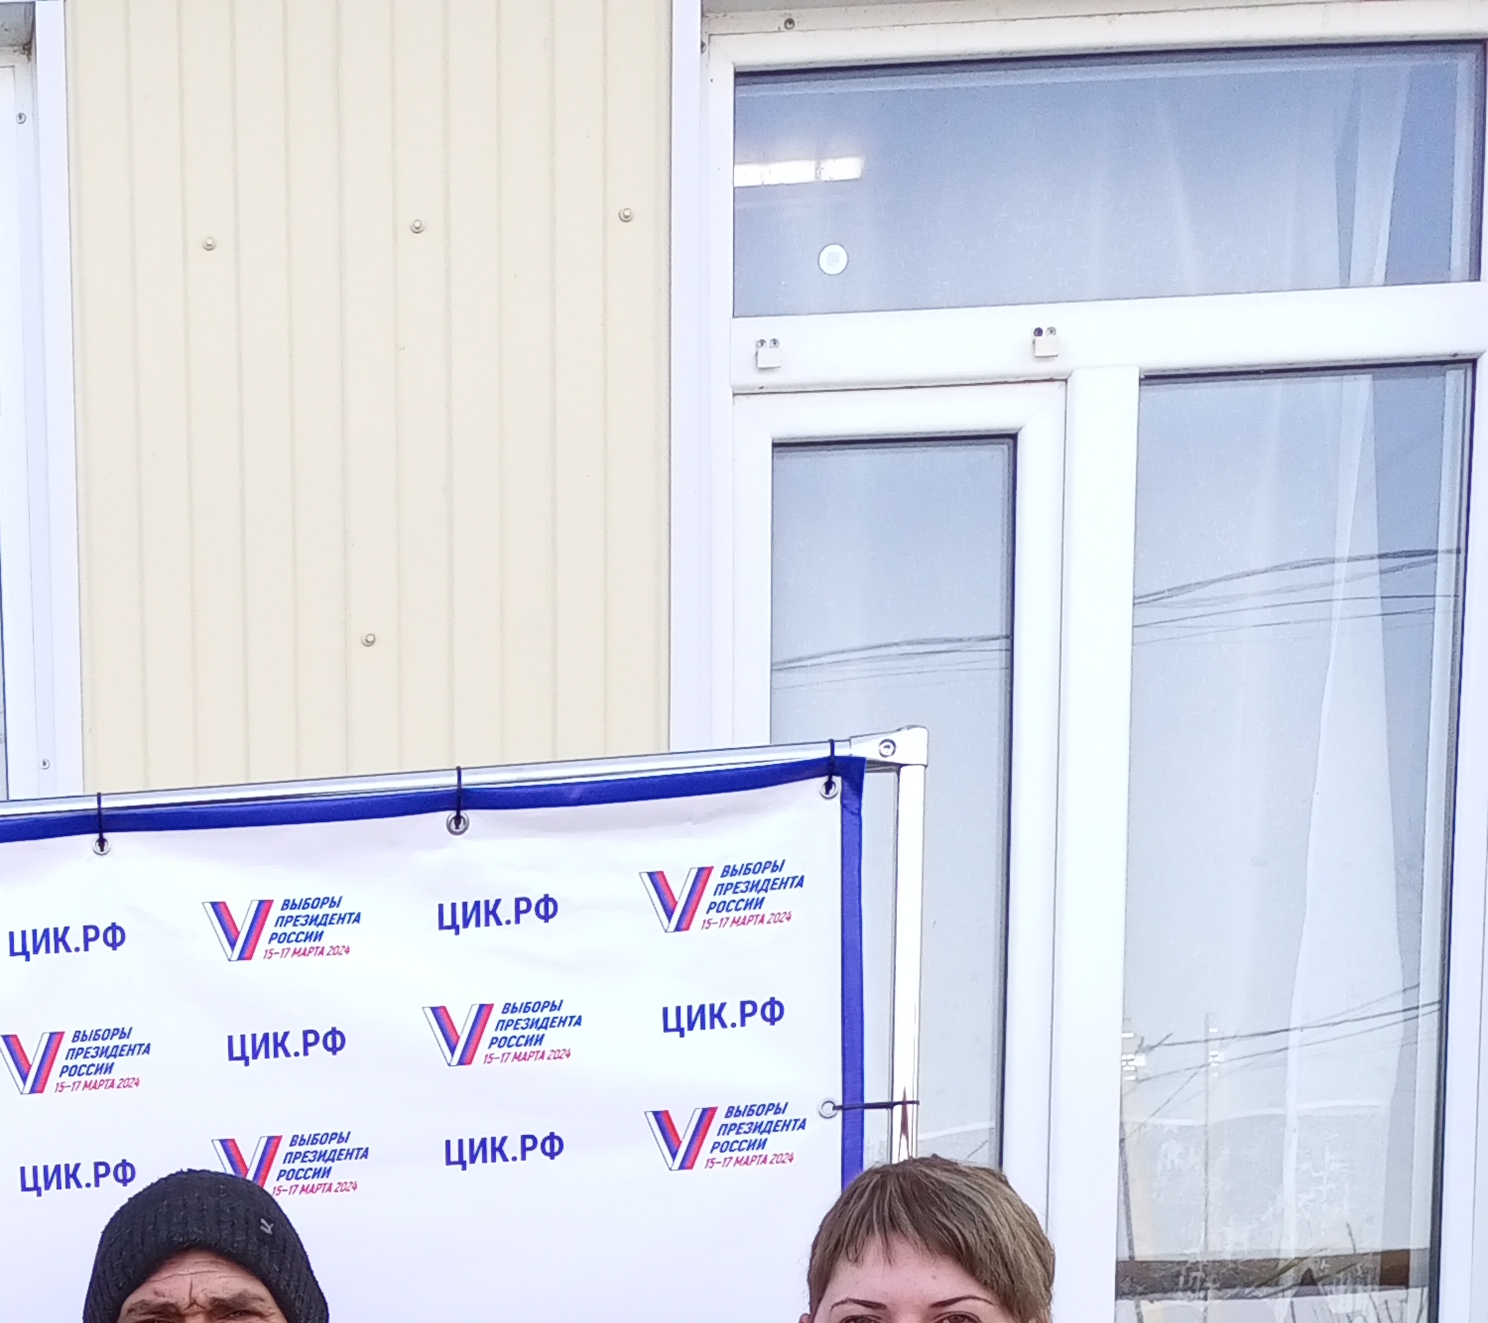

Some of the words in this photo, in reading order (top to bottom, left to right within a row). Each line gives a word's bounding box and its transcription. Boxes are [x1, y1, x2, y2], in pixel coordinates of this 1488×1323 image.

[720, 859, 786, 878] ВЫБОРЫ
[713, 875, 804, 896] ПРЕЗИДЕНТА
[280, 896, 342, 911] ВЫБОРЫ
[706, 896, 765, 914] РОССИИ
[274, 912, 361, 928] ПРЕЗИДЕНТА
[438, 894, 558, 935] ЦИК.РФ
[730, 914, 765, 927] МАРТА
[767, 912, 791, 924] 2024
[9, 922, 125, 961] ЦИК.РФ
[268, 930, 324, 944] РОССИИ
[292, 946, 324, 957] МАРТА
[326, 946, 350, 956] 2024
[501, 1000, 564, 1014] ВЫБОРЫ
[495, 1015, 582, 1032] ПРЕЗИДЕНТА
[663, 997, 784, 1038] ЦИК.РФ
[72, 1027, 132, 1043] ВЫБОРЫ
[488, 1034, 545, 1049] РОССИИ
[65, 1043, 151, 1060] ПРЕЗИДЕНТА
[228, 1027, 345, 1067] ЦИК.РФ
[512, 1050, 545, 1062] МАРТА
[547, 1049, 570, 1060] 2024
[59, 1062, 114, 1078] РОССИИ
[82, 1079, 115, 1090] МАРТА
[116, 1077, 140, 1088] 2024
[724, 1102, 788, 1118] ВЫБОРЫ
[717, 1118, 806, 1136] ПРЕЗИДЕНТА
[289, 1131, 351, 1147] ВЫБОРЫ
[710, 1138, 768, 1154] РОССИИ
[282, 1147, 369, 1164] ПРЕЗИДЕНТА
[445, 1132, 564, 1171] ЦИК.РФ
[734, 1154, 768, 1166] МАРТА
[769, 1153, 794, 1164] 2024
[20, 1159, 136, 1197] ЦИК.РФ
[276, 1166, 332, 1181] РОССИИ
[299, 1183, 332, 1194] МАРТА
[334, 1182, 357, 1192] 2024
